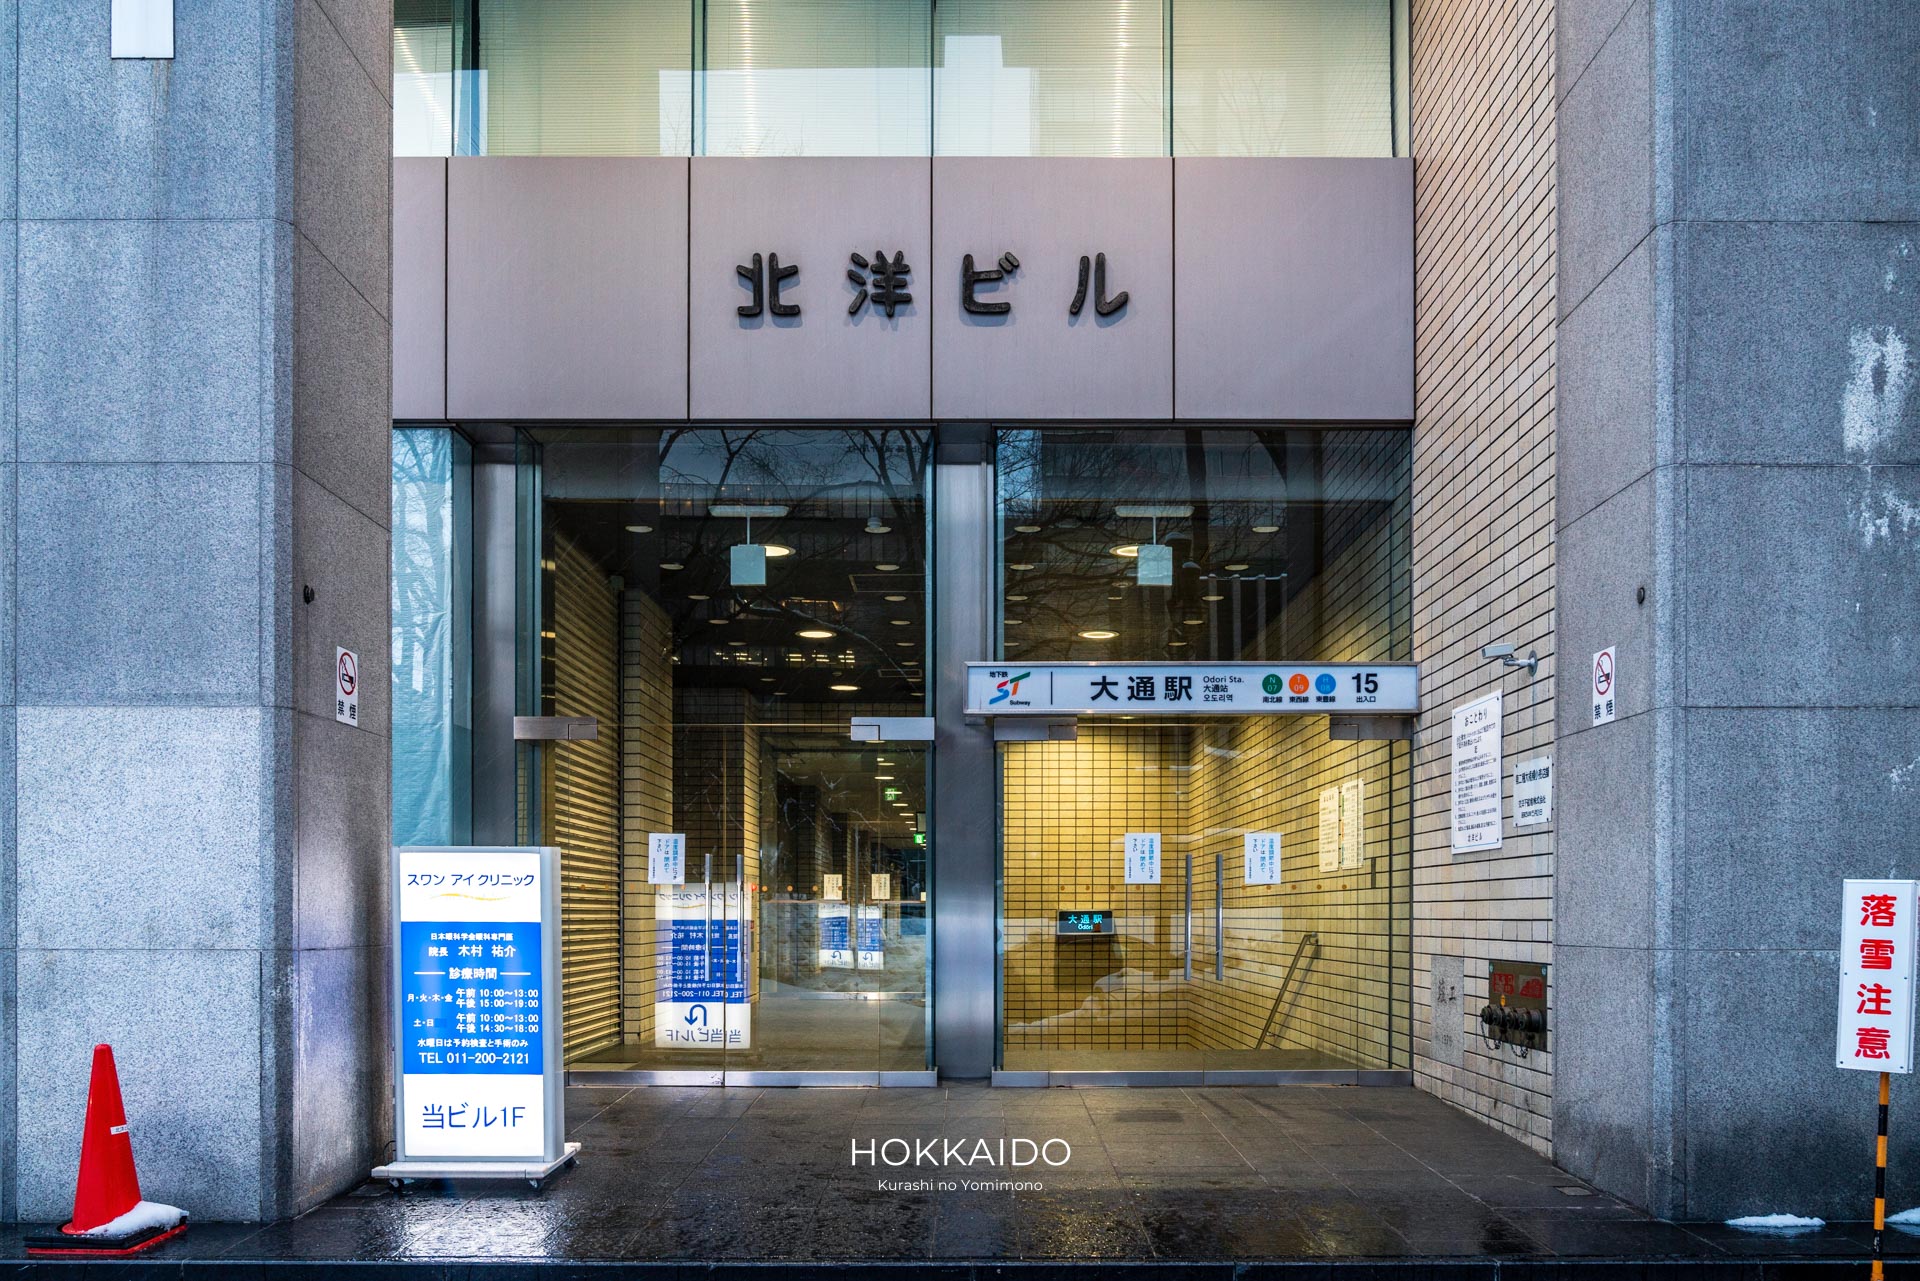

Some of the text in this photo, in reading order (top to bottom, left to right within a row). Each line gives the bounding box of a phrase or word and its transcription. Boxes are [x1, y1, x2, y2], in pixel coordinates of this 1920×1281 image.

[736, 250, 1129, 317] 北洋ビル
[1203, 675, 1244, 683] Odori Sta.
[1352, 673, 1379, 694] 15
[1090, 673, 1193, 701] 大通駅
[1203, 684, 1228, 693] 大通站
[1203, 694, 1233, 703] 오도리역
[1262, 696, 1283, 704] 南北線
[1289, 696, 1310, 704] 東西線
[1464, 708, 1488, 727] おことわり
[407, 874, 535, 887] スワン アイ クリニック
[1068, 914, 1103, 924] 大通駅
[428, 944, 516, 957] 院長 木村 祐介
[449, 967, 498, 980] 診療時間
[1855, 894, 1897, 1060] 落雪注意
[456, 988, 476, 998] 午前
[456, 998, 476, 1008] 午後
[456, 1013, 476, 1023] 午前
[456, 1023, 476, 1033] 午後
[417, 1038, 529, 1048] 水曜日は予約検査と手術のみ
[419, 1052, 529, 1064] TEL 011-200-2121
[422, 1102, 526, 1130] 当ビル1F
